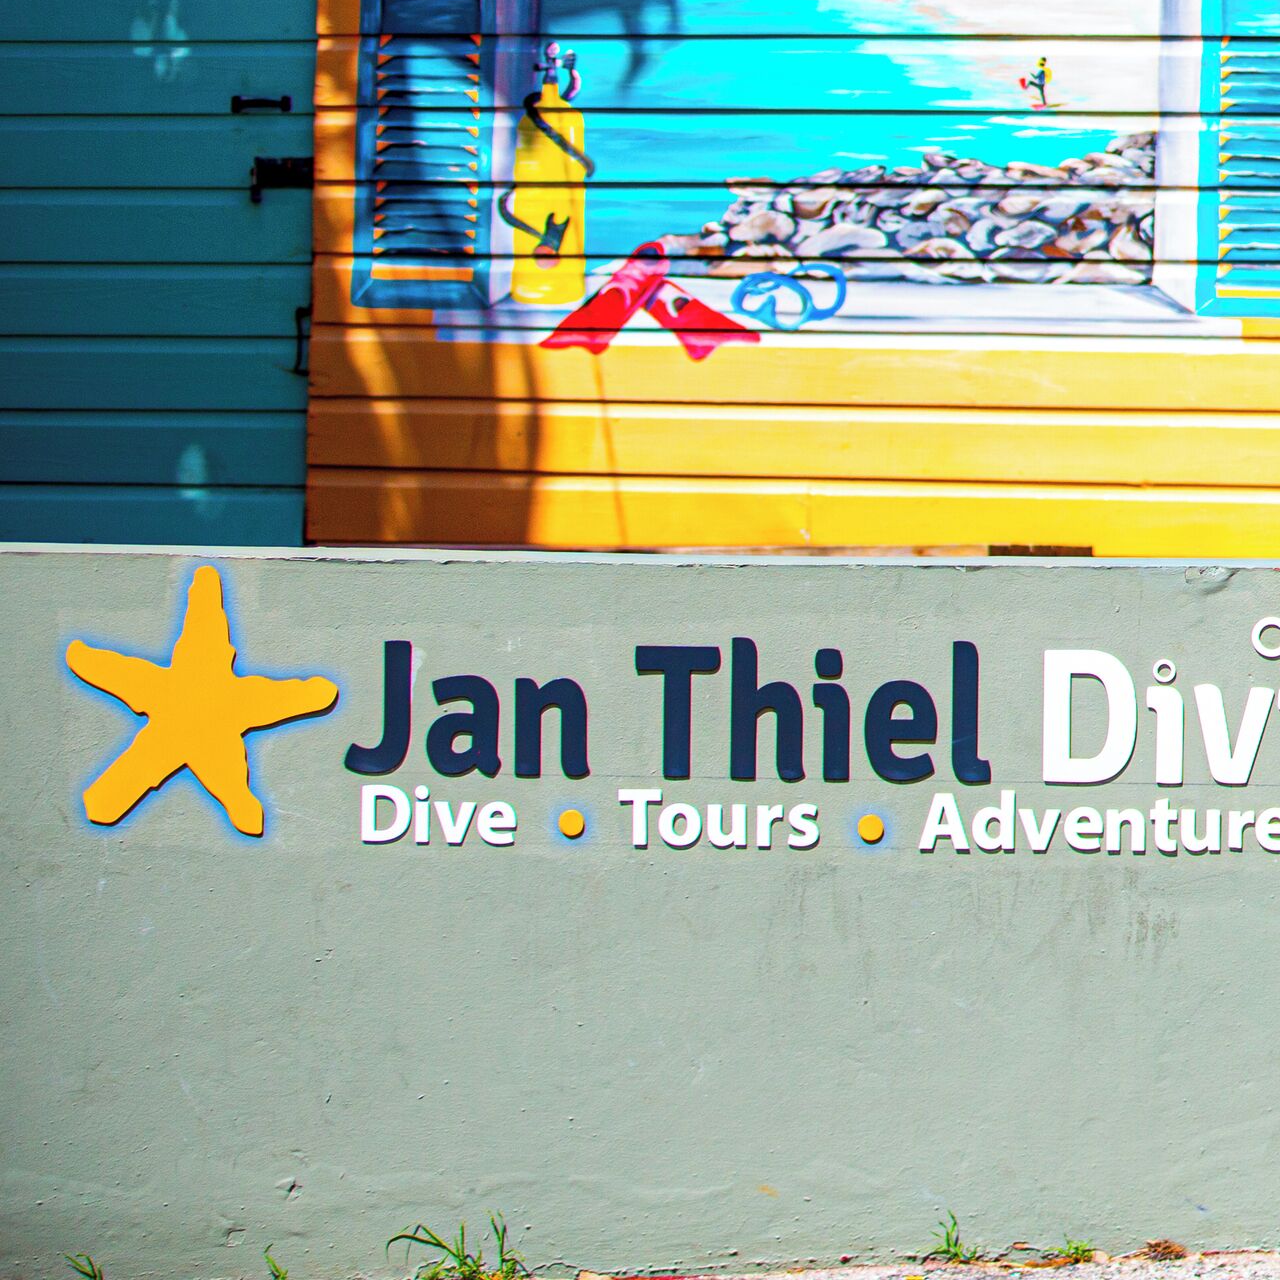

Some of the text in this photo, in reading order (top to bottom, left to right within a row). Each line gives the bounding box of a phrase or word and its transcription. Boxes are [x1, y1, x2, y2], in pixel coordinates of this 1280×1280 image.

[344, 639, 594, 781] Jan
[632, 637, 992, 786] Thiel
[359, 784, 518, 848] Dive
[618, 787, 821, 851] Tours
